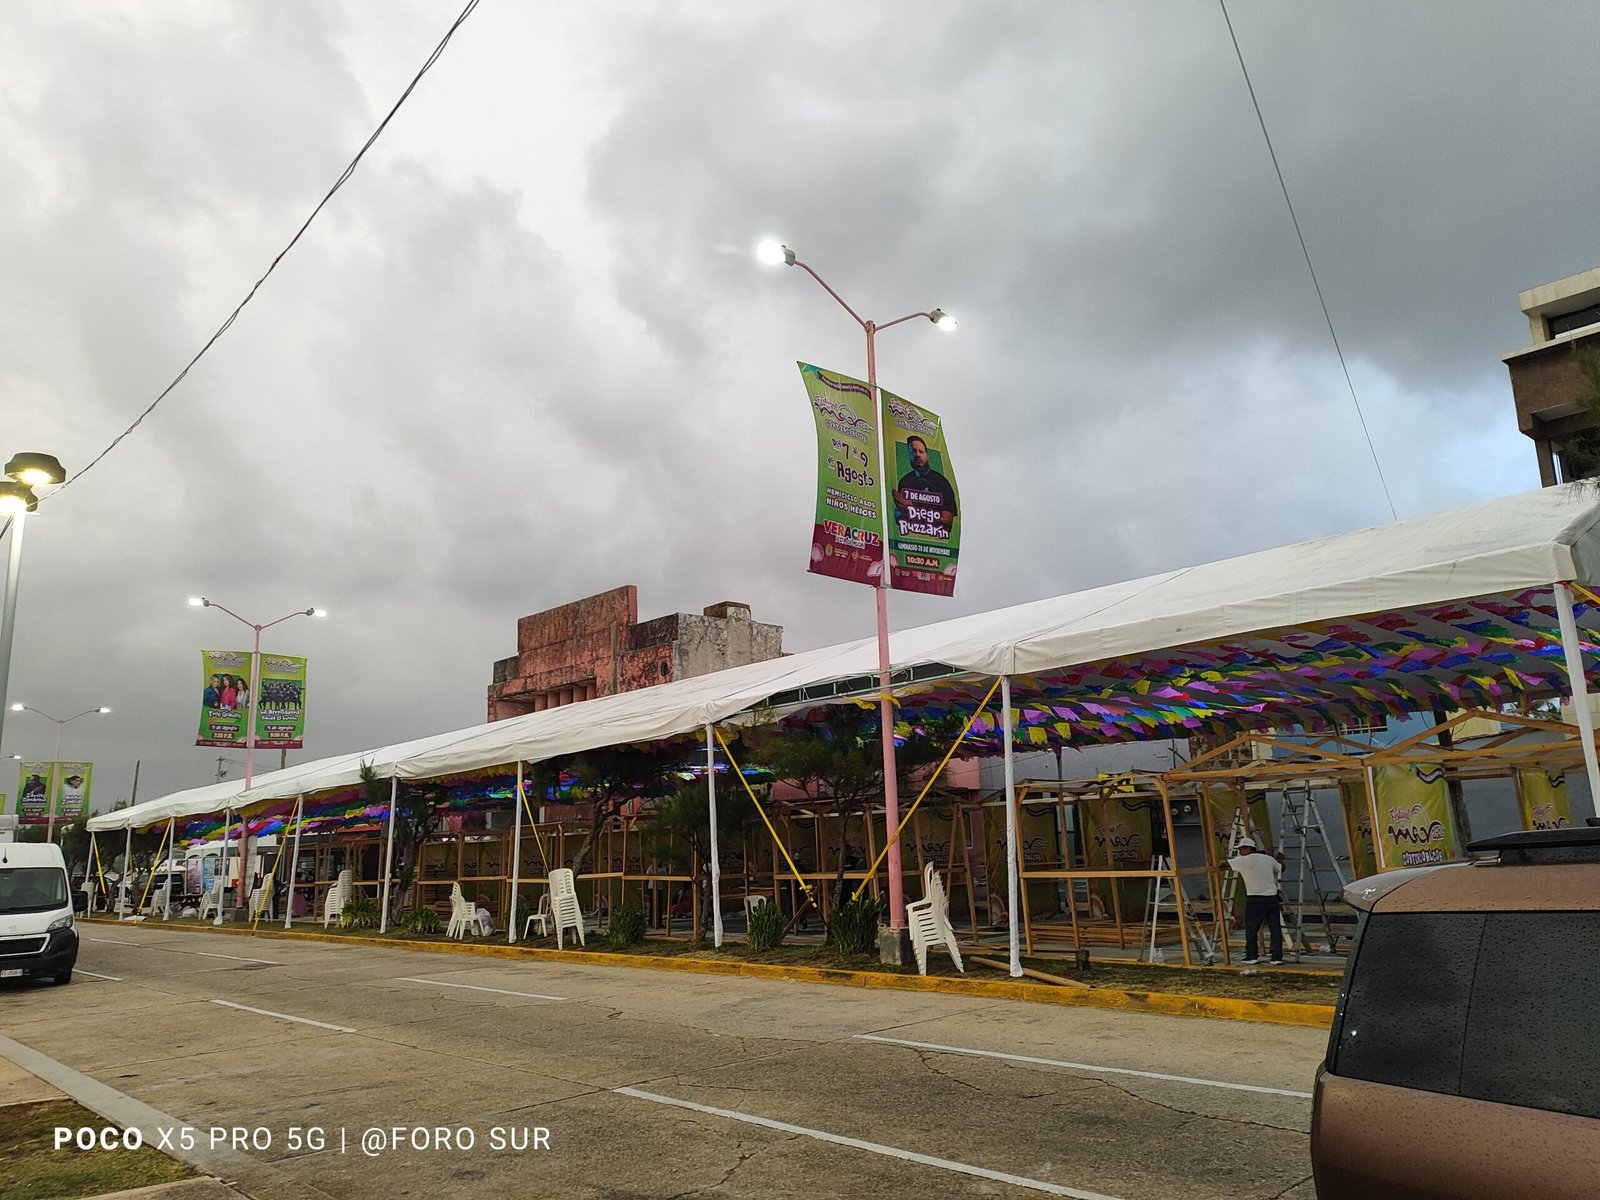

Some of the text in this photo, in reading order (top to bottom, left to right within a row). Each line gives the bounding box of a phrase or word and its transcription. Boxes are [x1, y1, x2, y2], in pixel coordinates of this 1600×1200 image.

[842, 442, 849, 460] 7
[860, 452, 868, 468] 9
[836, 460, 874, 486] Agosto
[826, 487, 858, 502] HEMICICLO
[904, 490, 940, 504] 7 DE AGOSTO
[826, 497, 876, 519] NIÑOS HÉROES
[908, 506, 940, 522] Diego
[824, 519, 880, 546] VERACRUZ
[899, 520, 949, 538] Ruzzarín
[906, 556, 924, 565] 10:30
